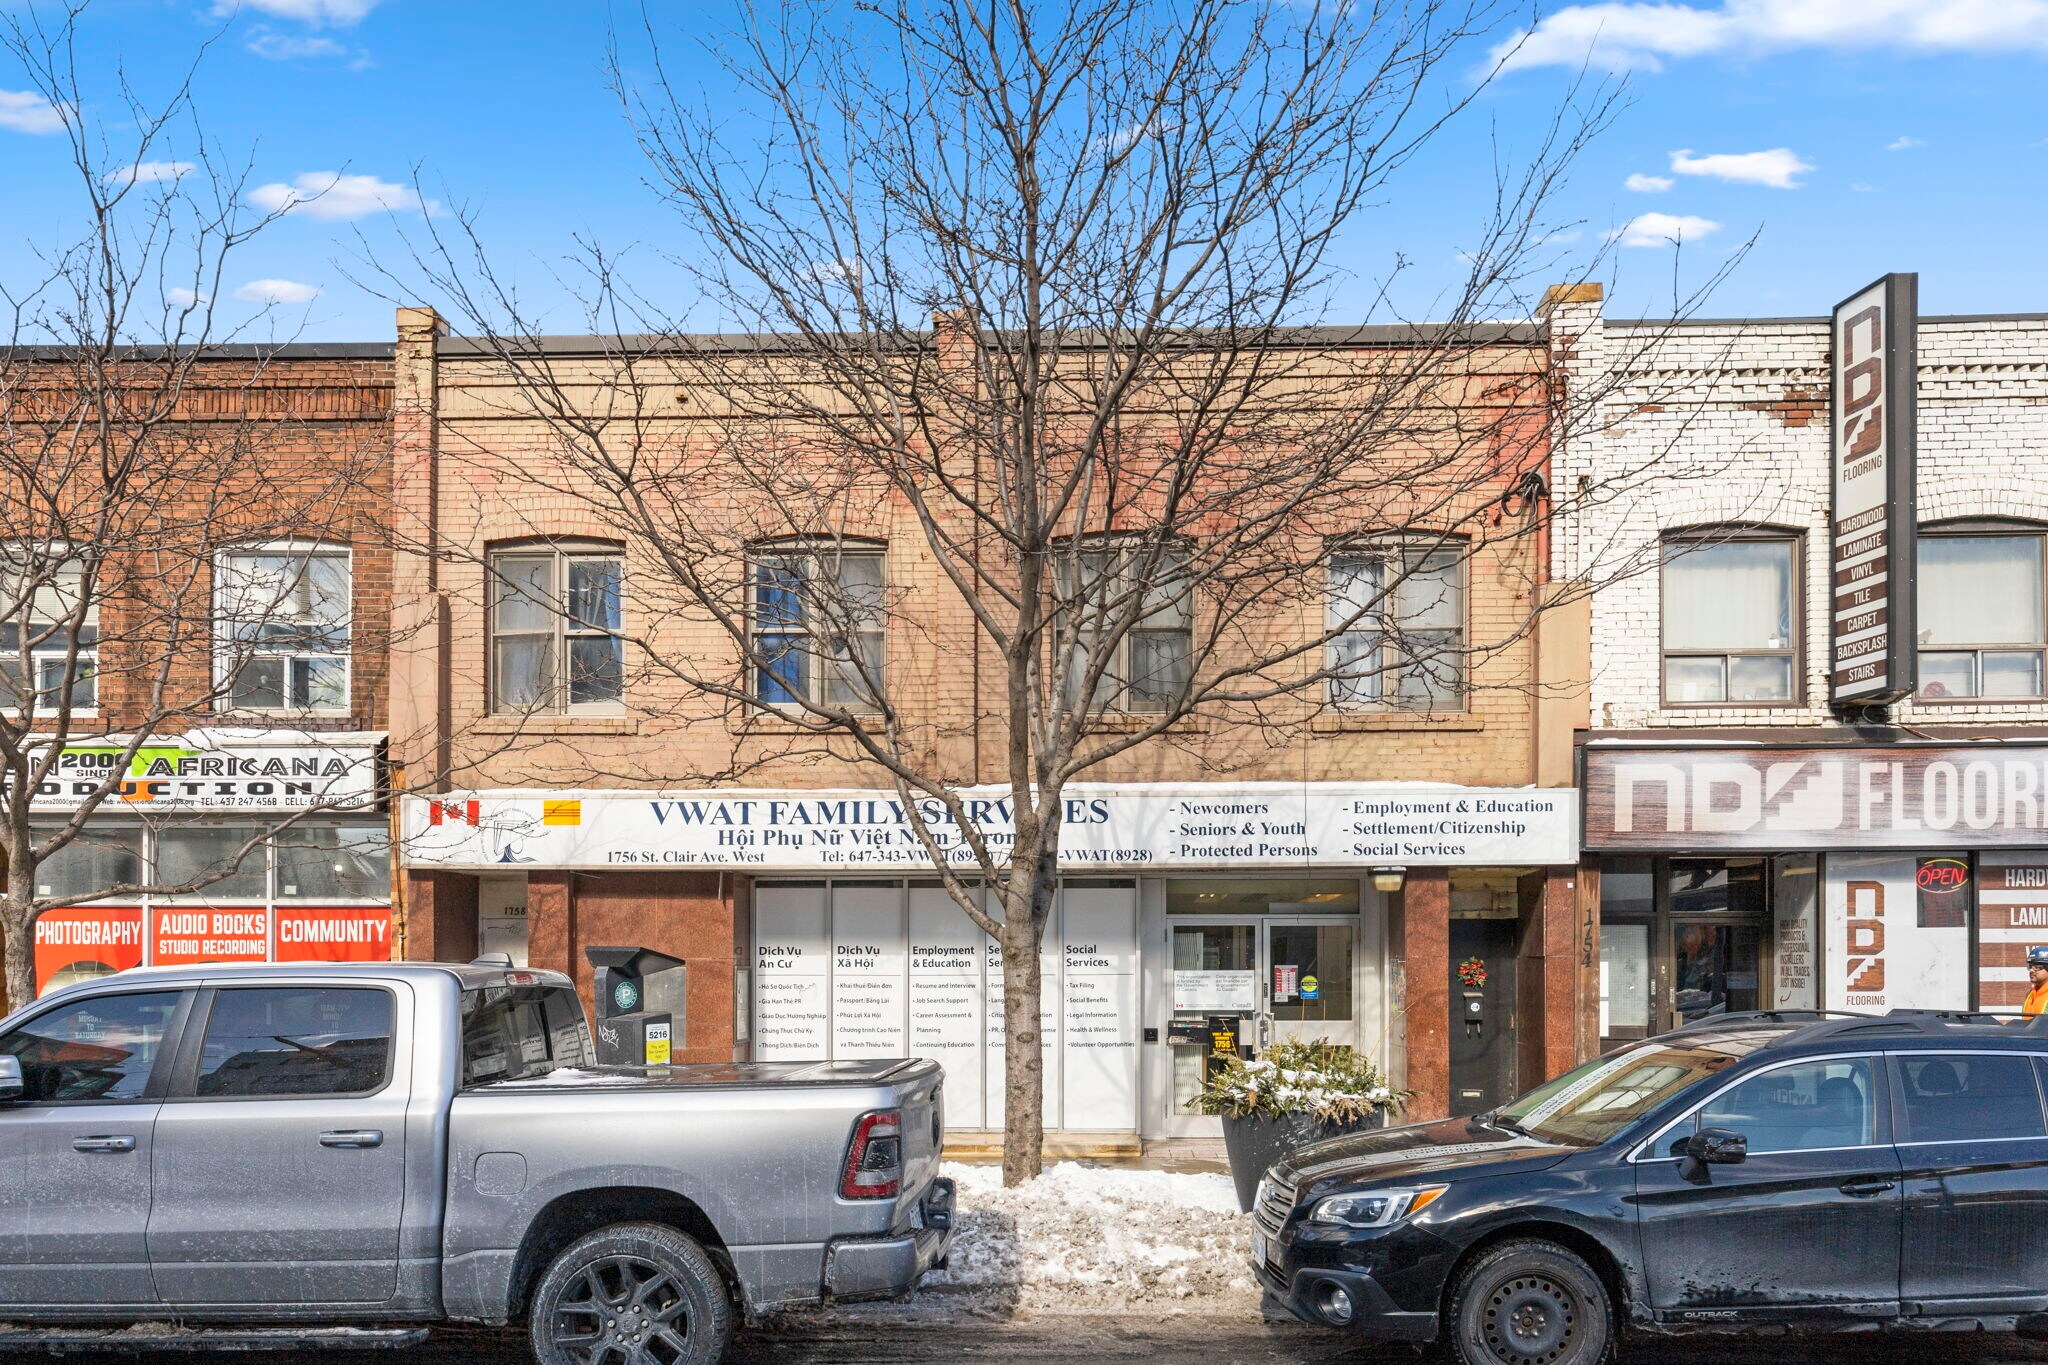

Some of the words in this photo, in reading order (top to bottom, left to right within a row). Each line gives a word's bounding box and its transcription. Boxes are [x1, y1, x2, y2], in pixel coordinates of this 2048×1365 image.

[1843, 454, 1882, 482] FLOORING
[1841, 507, 1884, 534] HARDWOOD
[1843, 533, 1882, 558] LAMINATE
[1851, 562, 1874, 581] VINYL
[1854, 588, 1870, 605] TILE
[1847, 612, 1877, 632] CARPET
[1837, 634, 1887, 660] BACKSPLASH
[1849, 664, 1875, 681] STAIRS
[147, 757, 349, 777] AFRICANA
[4, 782, 312, 796] ODUCTION
[220, 797, 235, 806] 437
[239, 797, 253, 806] 247
[257, 797, 277, 806] 4568
[286, 797, 308, 806] CELL:
[1180, 801, 1268, 815] Newcomers
[1353, 801, 1451, 818] Employment
[1455, 800, 1469, 814] &
[1475, 799, 1553, 814] Education
[649, 801, 757, 826] VWAT
[768, 801, 907, 826] FAMILY
[1180, 822, 1237, 836] Seniors
[1240, 822, 1255, 836] &
[1261, 821, 1305, 836] Youth
[1353, 820, 1526, 837] Settlement/Citizenship
[718, 829, 754, 849] Hội
[763, 829, 803, 849] Phụ
[811, 828, 844, 846] Nữ
[850, 829, 892, 849] Việt
[607, 851, 637, 863] 1756
[641, 851, 658, 863] St.
[662, 851, 697, 863] Clair
[699, 851, 728, 863] Ave.
[733, 851, 765, 863] West
[820, 850, 844, 862] Tel:
[1181, 843, 1253, 857] Protected
[1258, 842, 1317, 857] Persons
[1353, 842, 1399, 857] Social
[1403, 842, 1465, 857] Services
[1917, 868, 1965, 886] OPEN
[2005, 868, 2048, 887] HARD
[504, 907, 526, 915] 1758
[2010, 907, 2048, 925] LAMI
[160, 913, 209, 935] AUDIO
[213, 913, 265, 935] BOOKS
[281, 919, 387, 943] COMMUNITY
[35, 921, 141, 945] PHOTOGRAPHY
[1580, 908, 1593, 967] 1754
[160, 939, 199, 955] STUDIO
[202, 939, 265, 955] RECORDING
[759, 946, 785, 957] Dịch
[787, 946, 801, 957] Vụ
[838, 945, 863, 956] Dịch
[865, 945, 880, 957] Vụ
[912, 945, 974, 957] Employment
[1066, 944, 1097, 954] Social
[759, 959, 775, 968] An
[913, 959, 920, 968] &
[922, 958, 971, 968] Education
[1066, 957, 1109, 967] Services
[1846, 995, 1885, 1005] FLOORING
[649, 1031, 667, 1039] 5216
